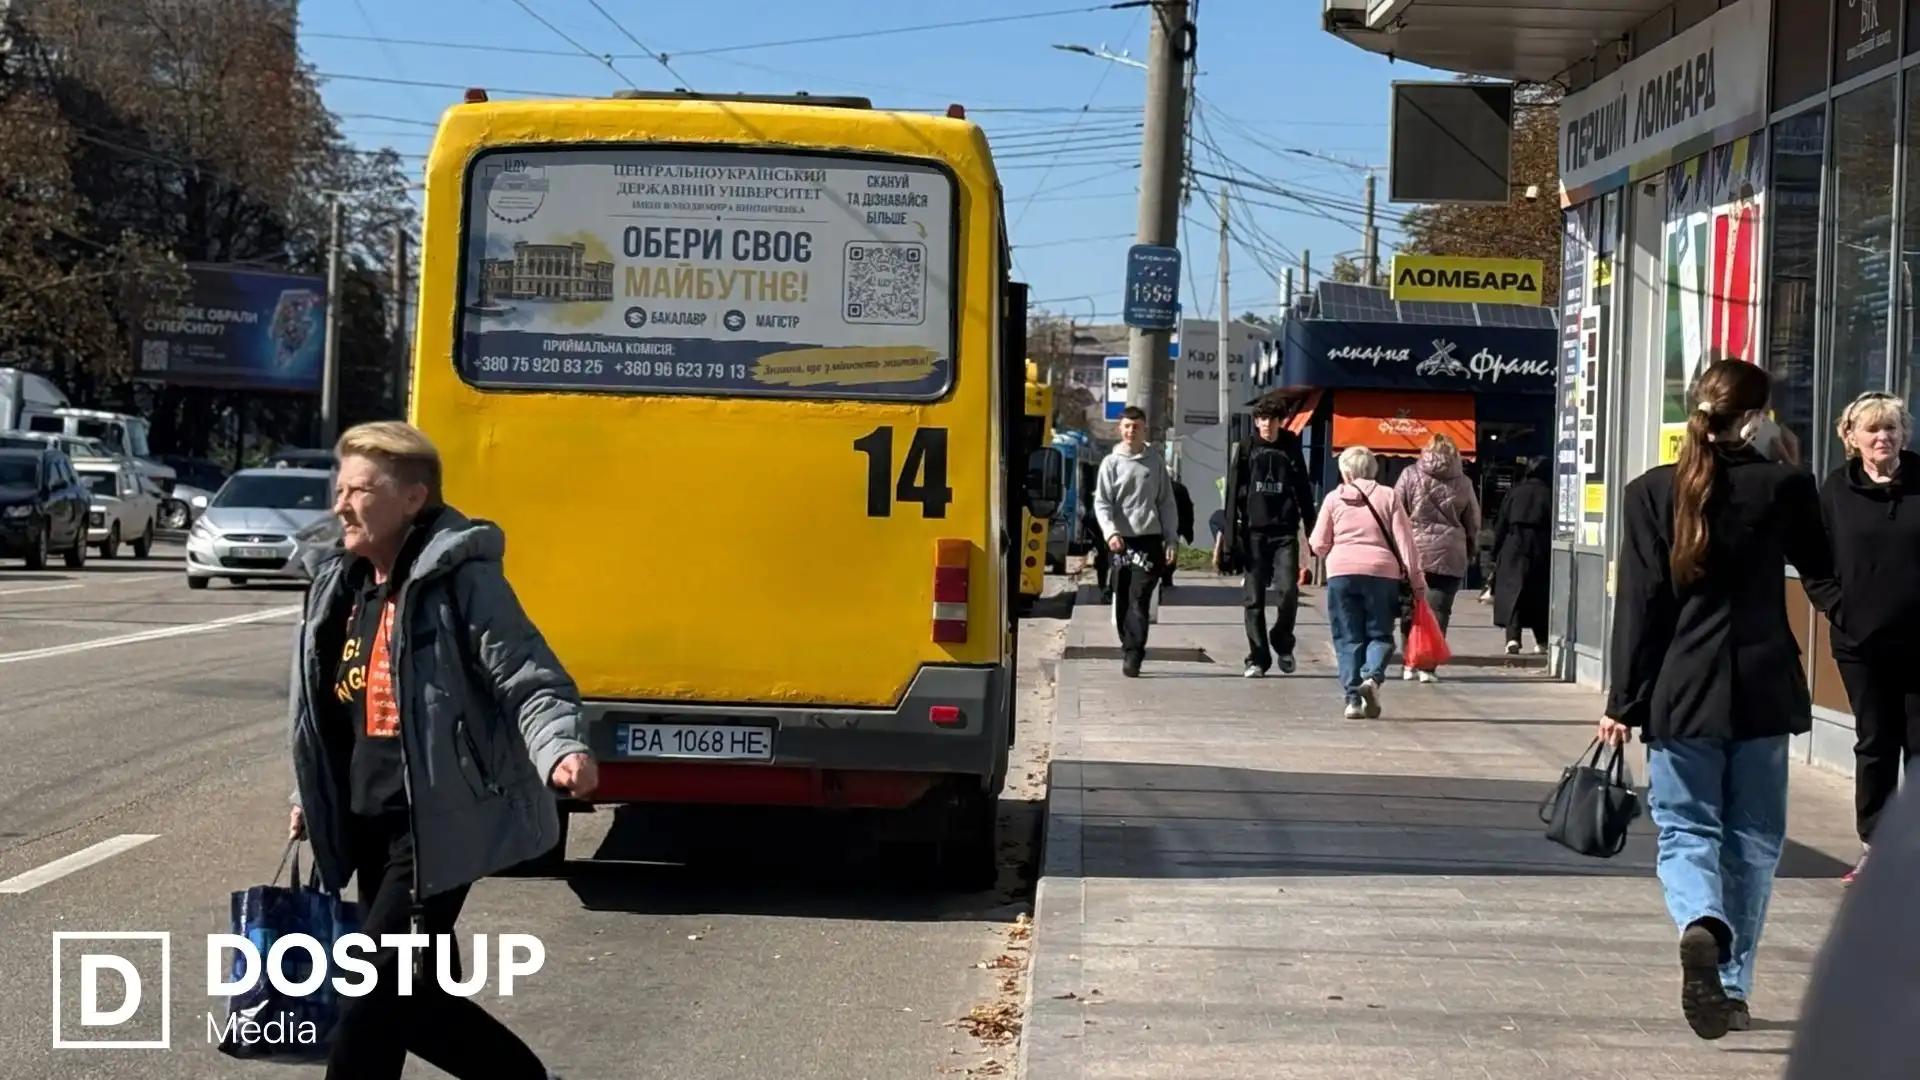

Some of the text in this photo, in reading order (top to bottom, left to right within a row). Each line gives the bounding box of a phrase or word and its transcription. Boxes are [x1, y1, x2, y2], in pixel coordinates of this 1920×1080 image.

[1565, 46, 1716, 173] ПЕРШИЙ ЛОМБАРД
[613, 164, 828, 183] ЦЕНТРАЛЬНОУКРАЇНСЬКИЙ
[866, 173, 910, 189] СКАНУЙ
[616, 182, 824, 200] ДЕРЖАВНИЙ УНІВЕРСИТЕТ
[846, 192, 929, 208] ТА ДІЗНАВАЙСЯ
[866, 211, 908, 225] БІЛЬШЕ
[623, 226, 813, 263] ОБЕРИ СВОЄ
[624, 262, 809, 303] МАЙБУТНЄ!
[1398, 267, 1537, 292] ЛОМБАРД
[207, 308, 259, 324] ОБРАЛИ
[651, 310, 800, 329] БАКАЛАВР МАГІСТР
[143, 319, 225, 336] СУПЕРСИЛУ?
[543, 339, 623, 354] ПРИЙМАЛЬНА
[473, 357, 603, 374] +380 75 920 83 25
[614, 361, 746, 379] +380 96 623 79 13
[1327, 345, 1558, 385] пекарня Франс.
[1187, 369, 1204, 380] не
[853, 425, 953, 519] 14
[631, 728, 663, 752] BA
[672, 729, 724, 753] 1068
[731, 731, 764, 754] HE
